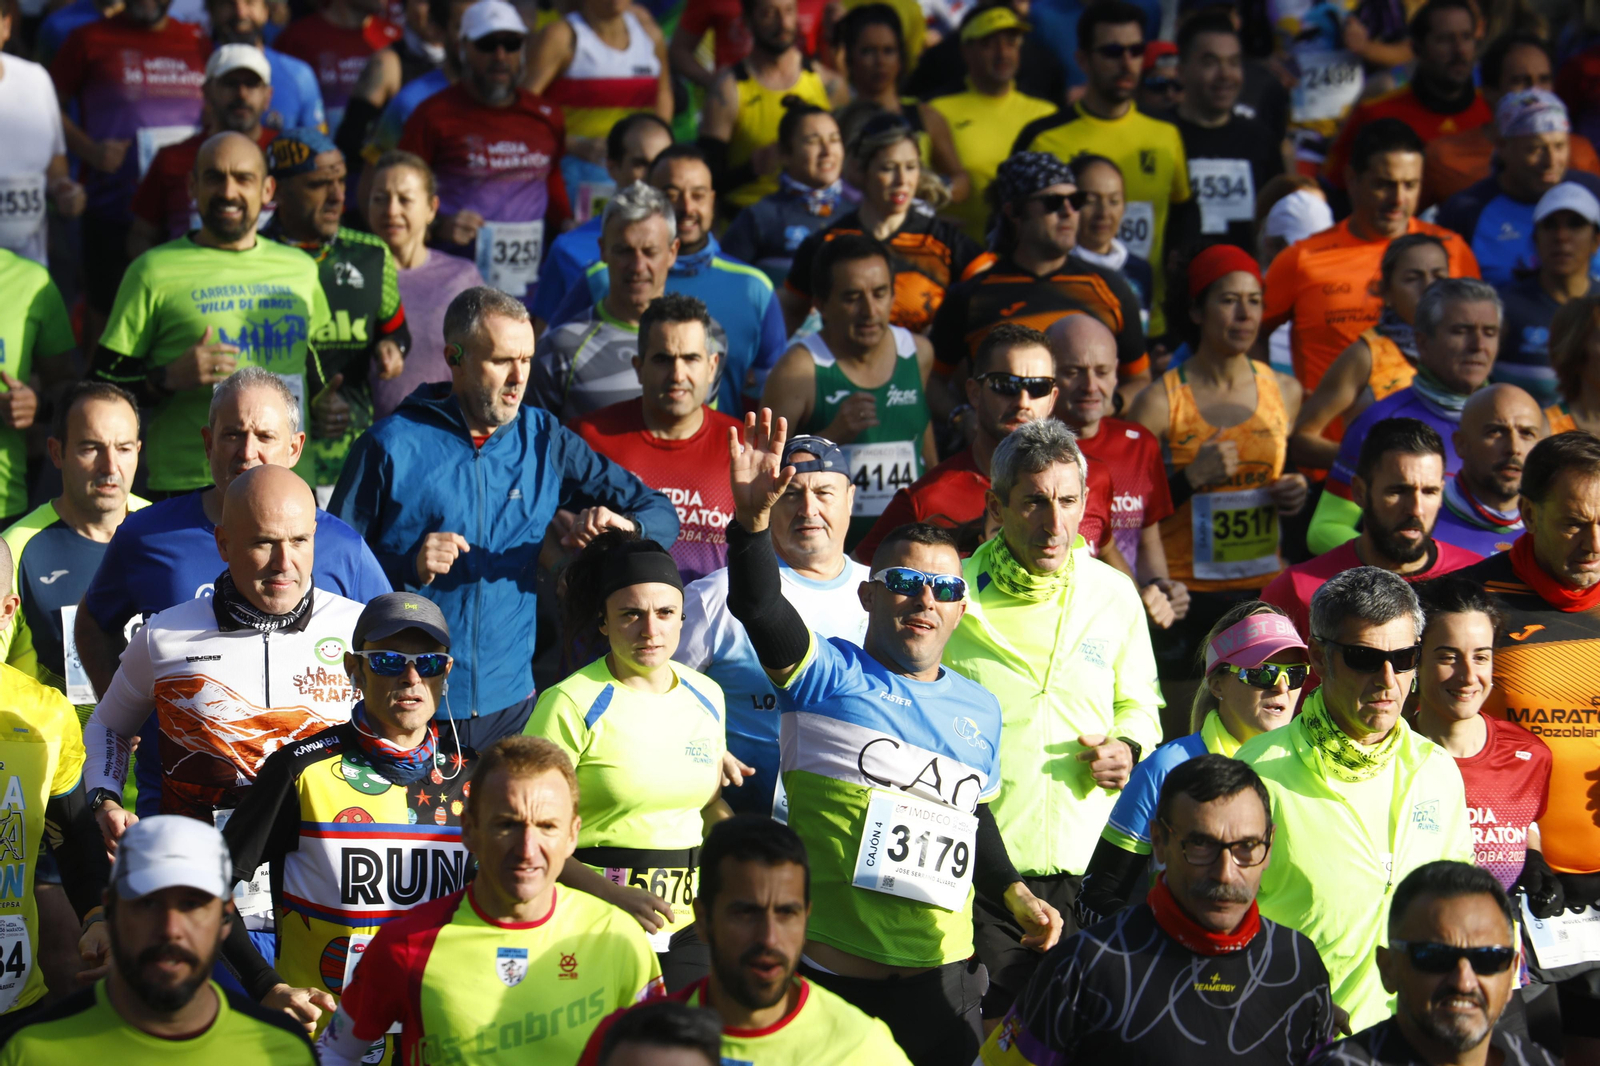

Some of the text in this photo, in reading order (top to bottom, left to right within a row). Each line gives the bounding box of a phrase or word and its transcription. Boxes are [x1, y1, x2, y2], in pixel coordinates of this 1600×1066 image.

[0, 189, 42, 215] 535
[190, 284, 294, 302] CARRERA URBANA
[853, 462, 913, 492] 4144
[658, 487, 703, 507] EDIA
[1213, 505, 1275, 540] 3517
[1217, 620, 1269, 655] WEST
[879, 690, 913, 708] FASTER
[908, 806, 951, 826] IMDECO
[866, 821, 884, 867] CAJÓN 4
[887, 824, 970, 879] 3179
[341, 847, 463, 906] RUN
[895, 867, 910, 876] JOSE
[629, 867, 693, 906] 5678
[1194, 983, 1237, 993] TEAMERGY
